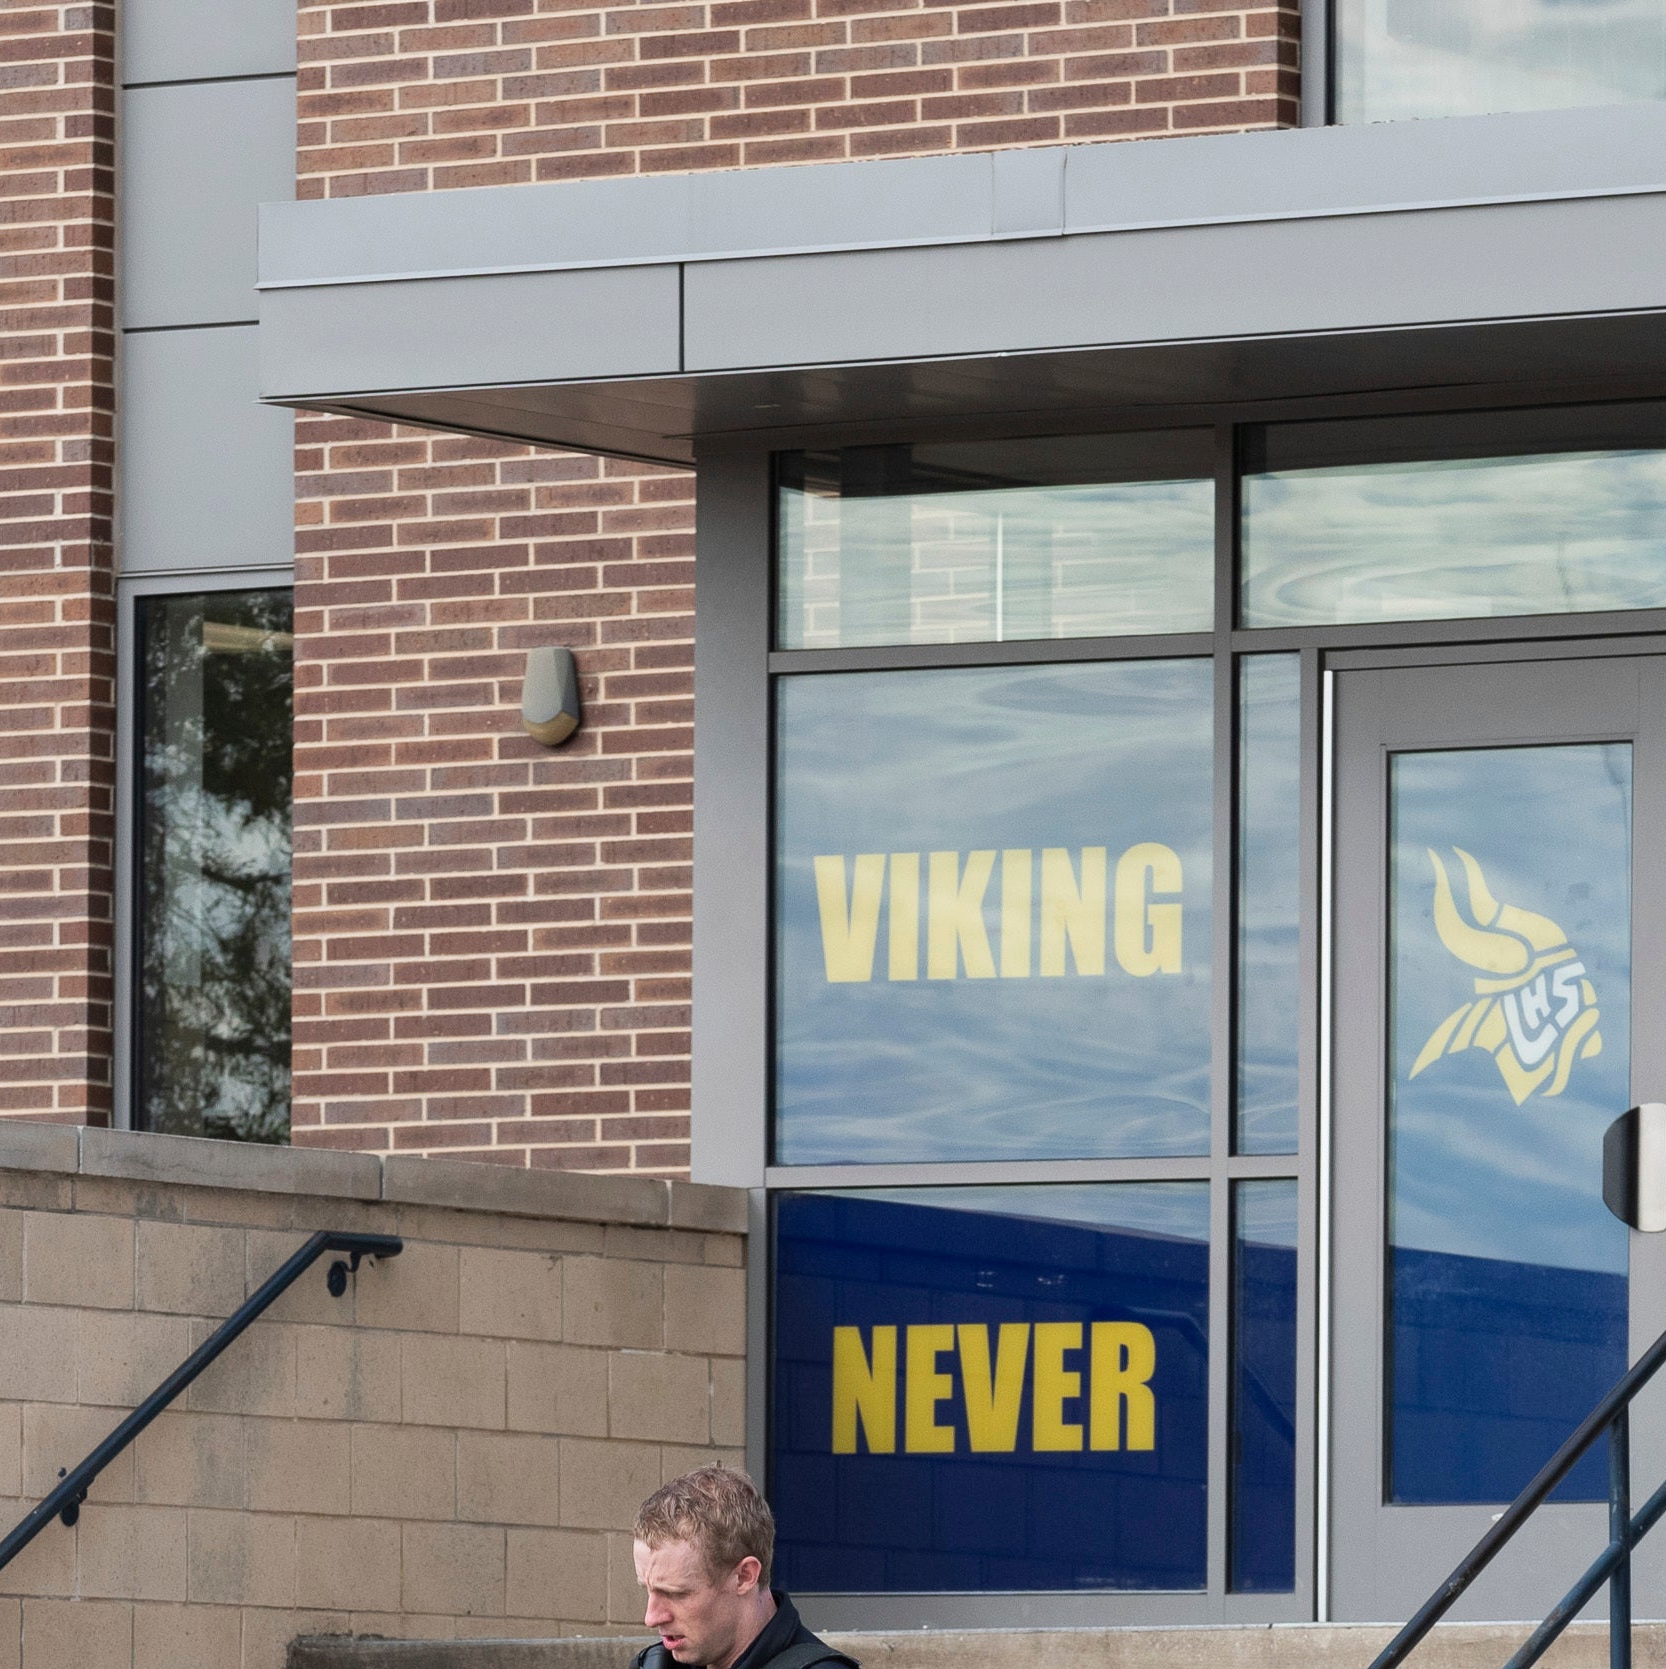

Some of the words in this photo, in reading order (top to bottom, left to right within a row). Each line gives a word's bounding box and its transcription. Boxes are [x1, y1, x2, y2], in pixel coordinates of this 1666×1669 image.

[814, 842, 1183, 983] VIKING
[1503, 961, 1586, 1065] LHS
[833, 1320, 1157, 1454] NEVER
